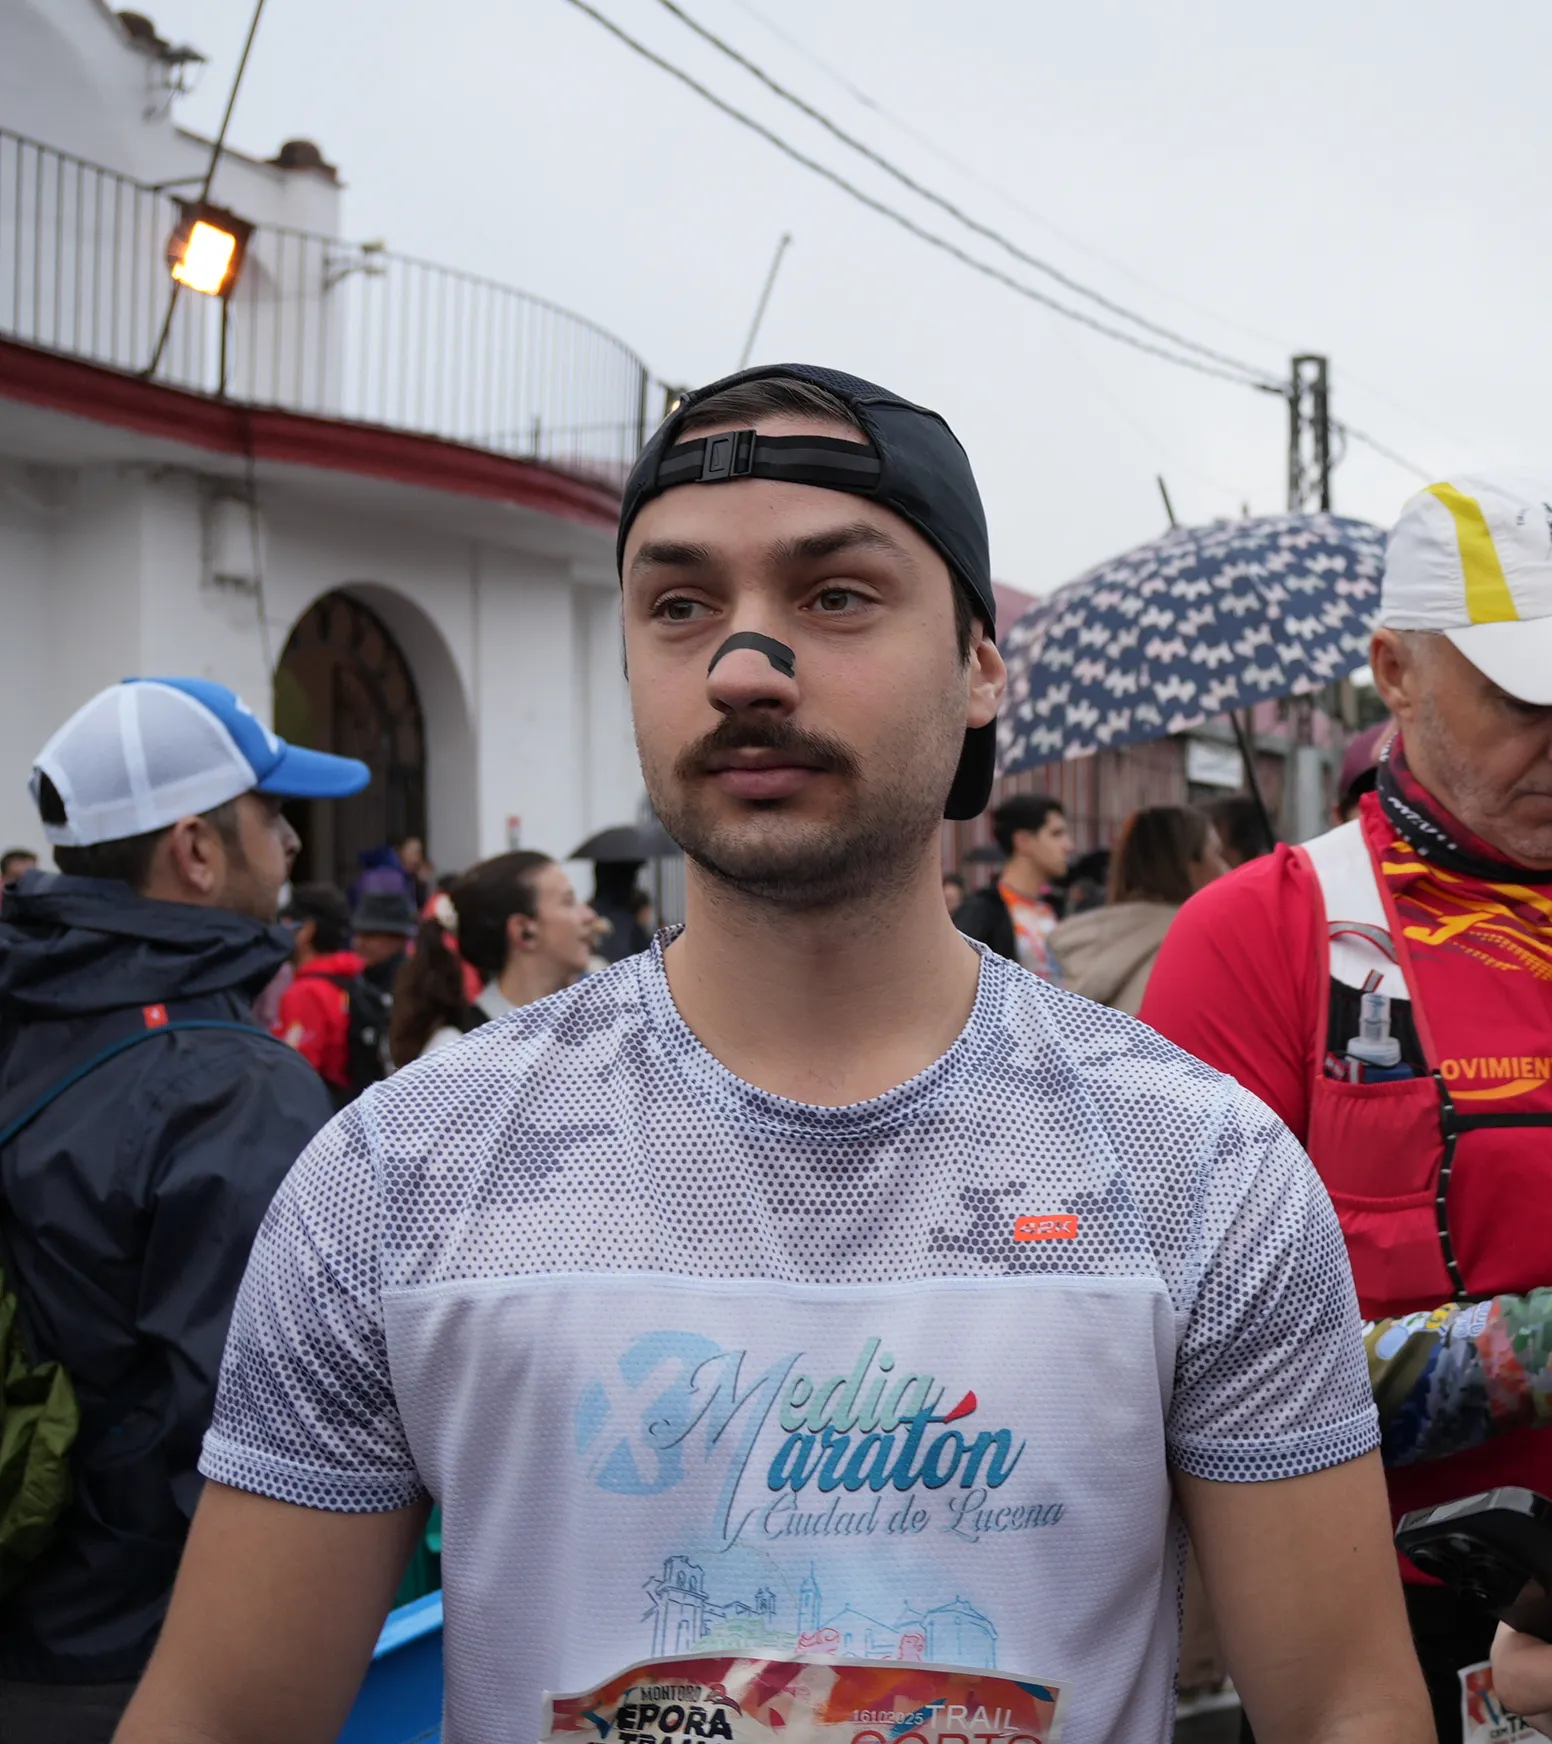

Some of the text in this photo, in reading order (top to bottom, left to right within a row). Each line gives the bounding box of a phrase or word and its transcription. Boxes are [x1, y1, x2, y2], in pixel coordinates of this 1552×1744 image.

[649, 1337, 946, 1475] Media
[763, 1488, 1065, 1544] Ciudad de Lucena
[616, 1703, 733, 1741] EPORA
[925, 1704, 1021, 1732] TRAIL
